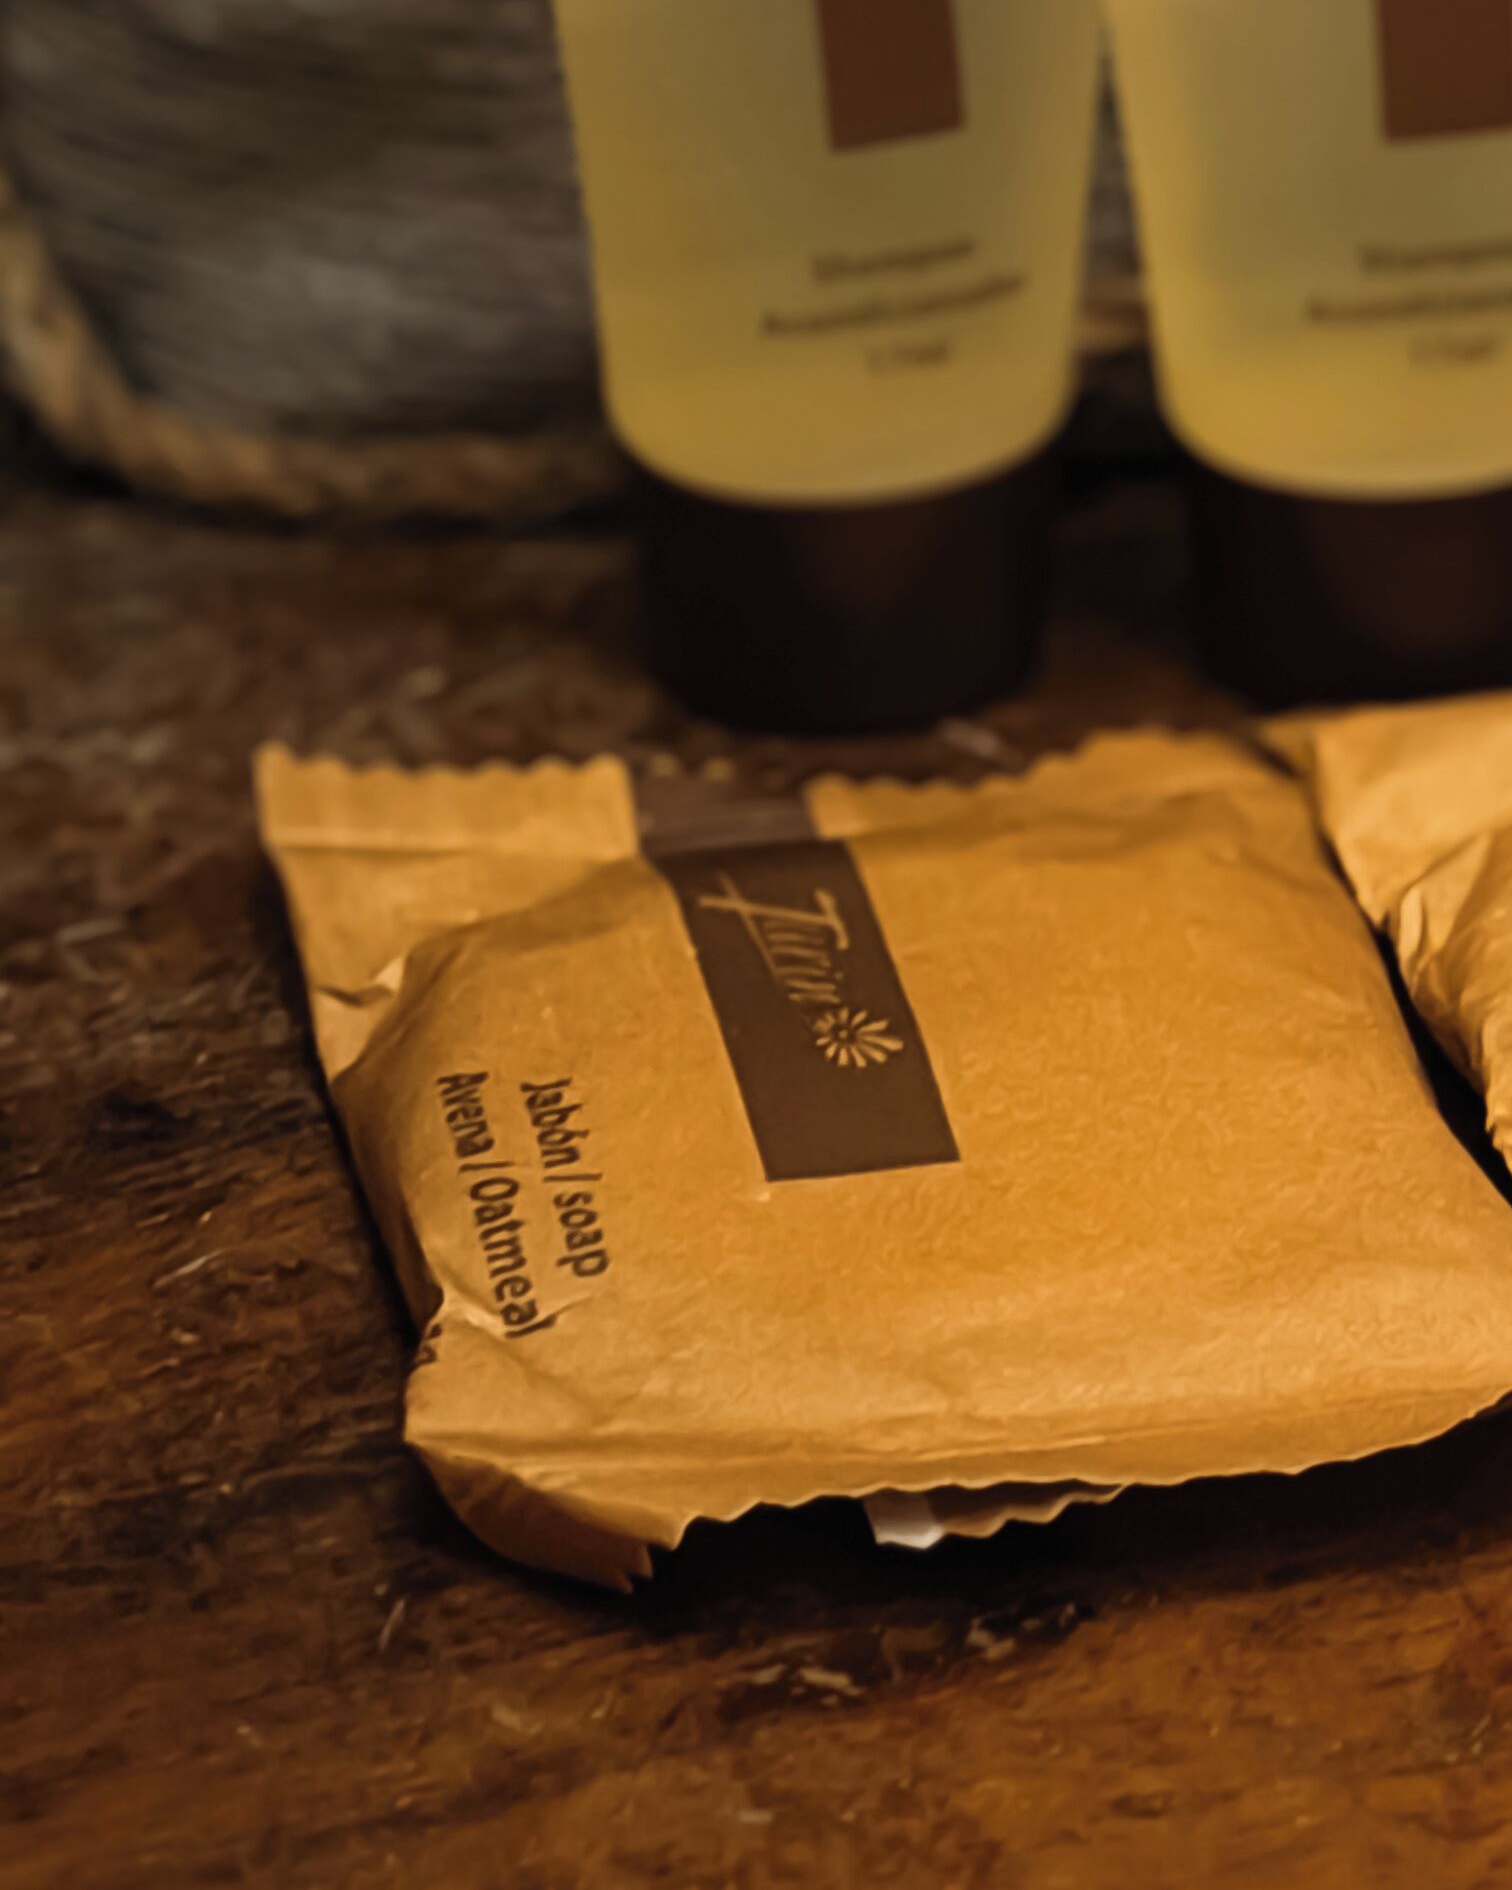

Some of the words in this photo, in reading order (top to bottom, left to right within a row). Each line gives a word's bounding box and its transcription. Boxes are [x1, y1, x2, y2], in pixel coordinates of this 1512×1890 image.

[435, 1070, 495, 1160] Avena
[469, 1176, 558, 1340] Oatmeal
[553, 1190, 611, 1279] soap
